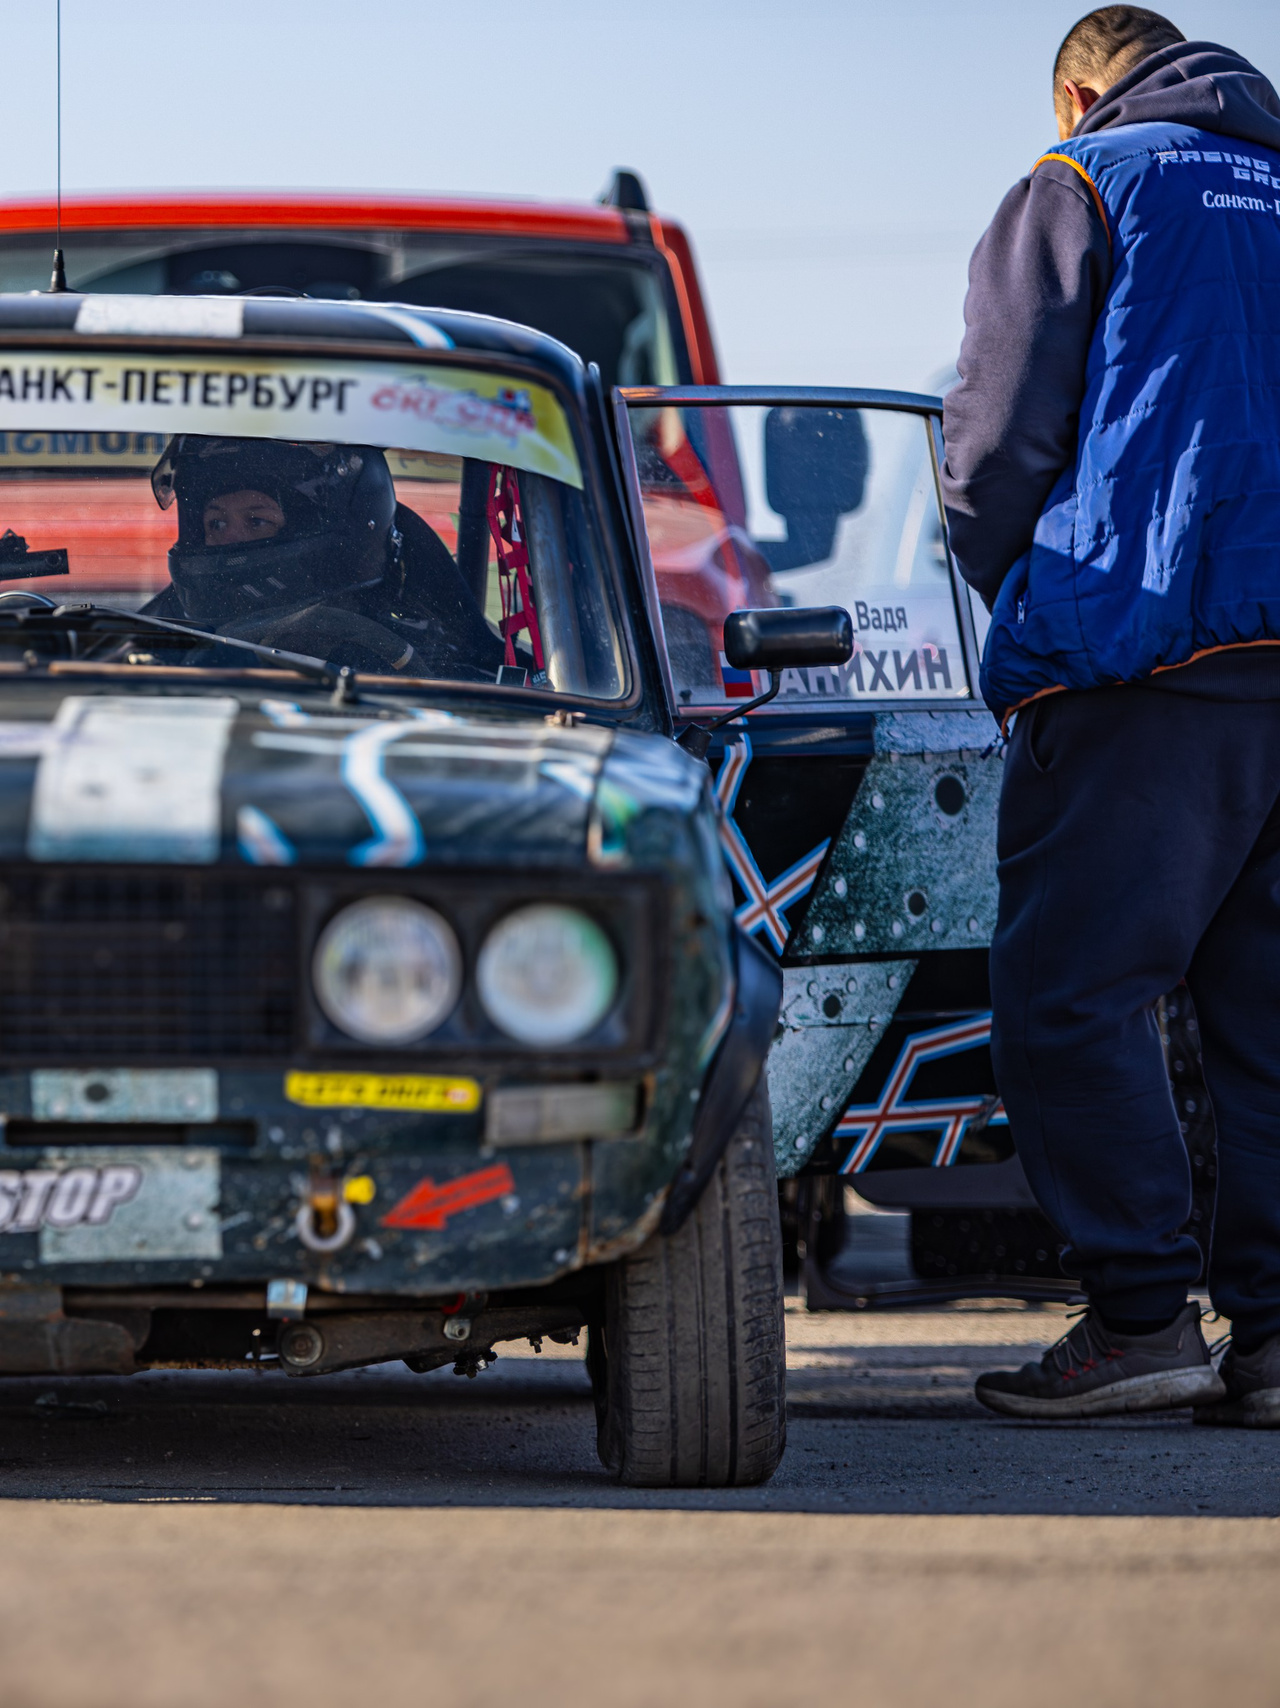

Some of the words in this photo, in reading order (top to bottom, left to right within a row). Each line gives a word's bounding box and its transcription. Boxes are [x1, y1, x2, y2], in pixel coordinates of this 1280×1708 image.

[1156, 150, 1270, 173] RACING
[854, 601, 908, 632] Вадя
[758, 647, 952, 695] АНИХИН
